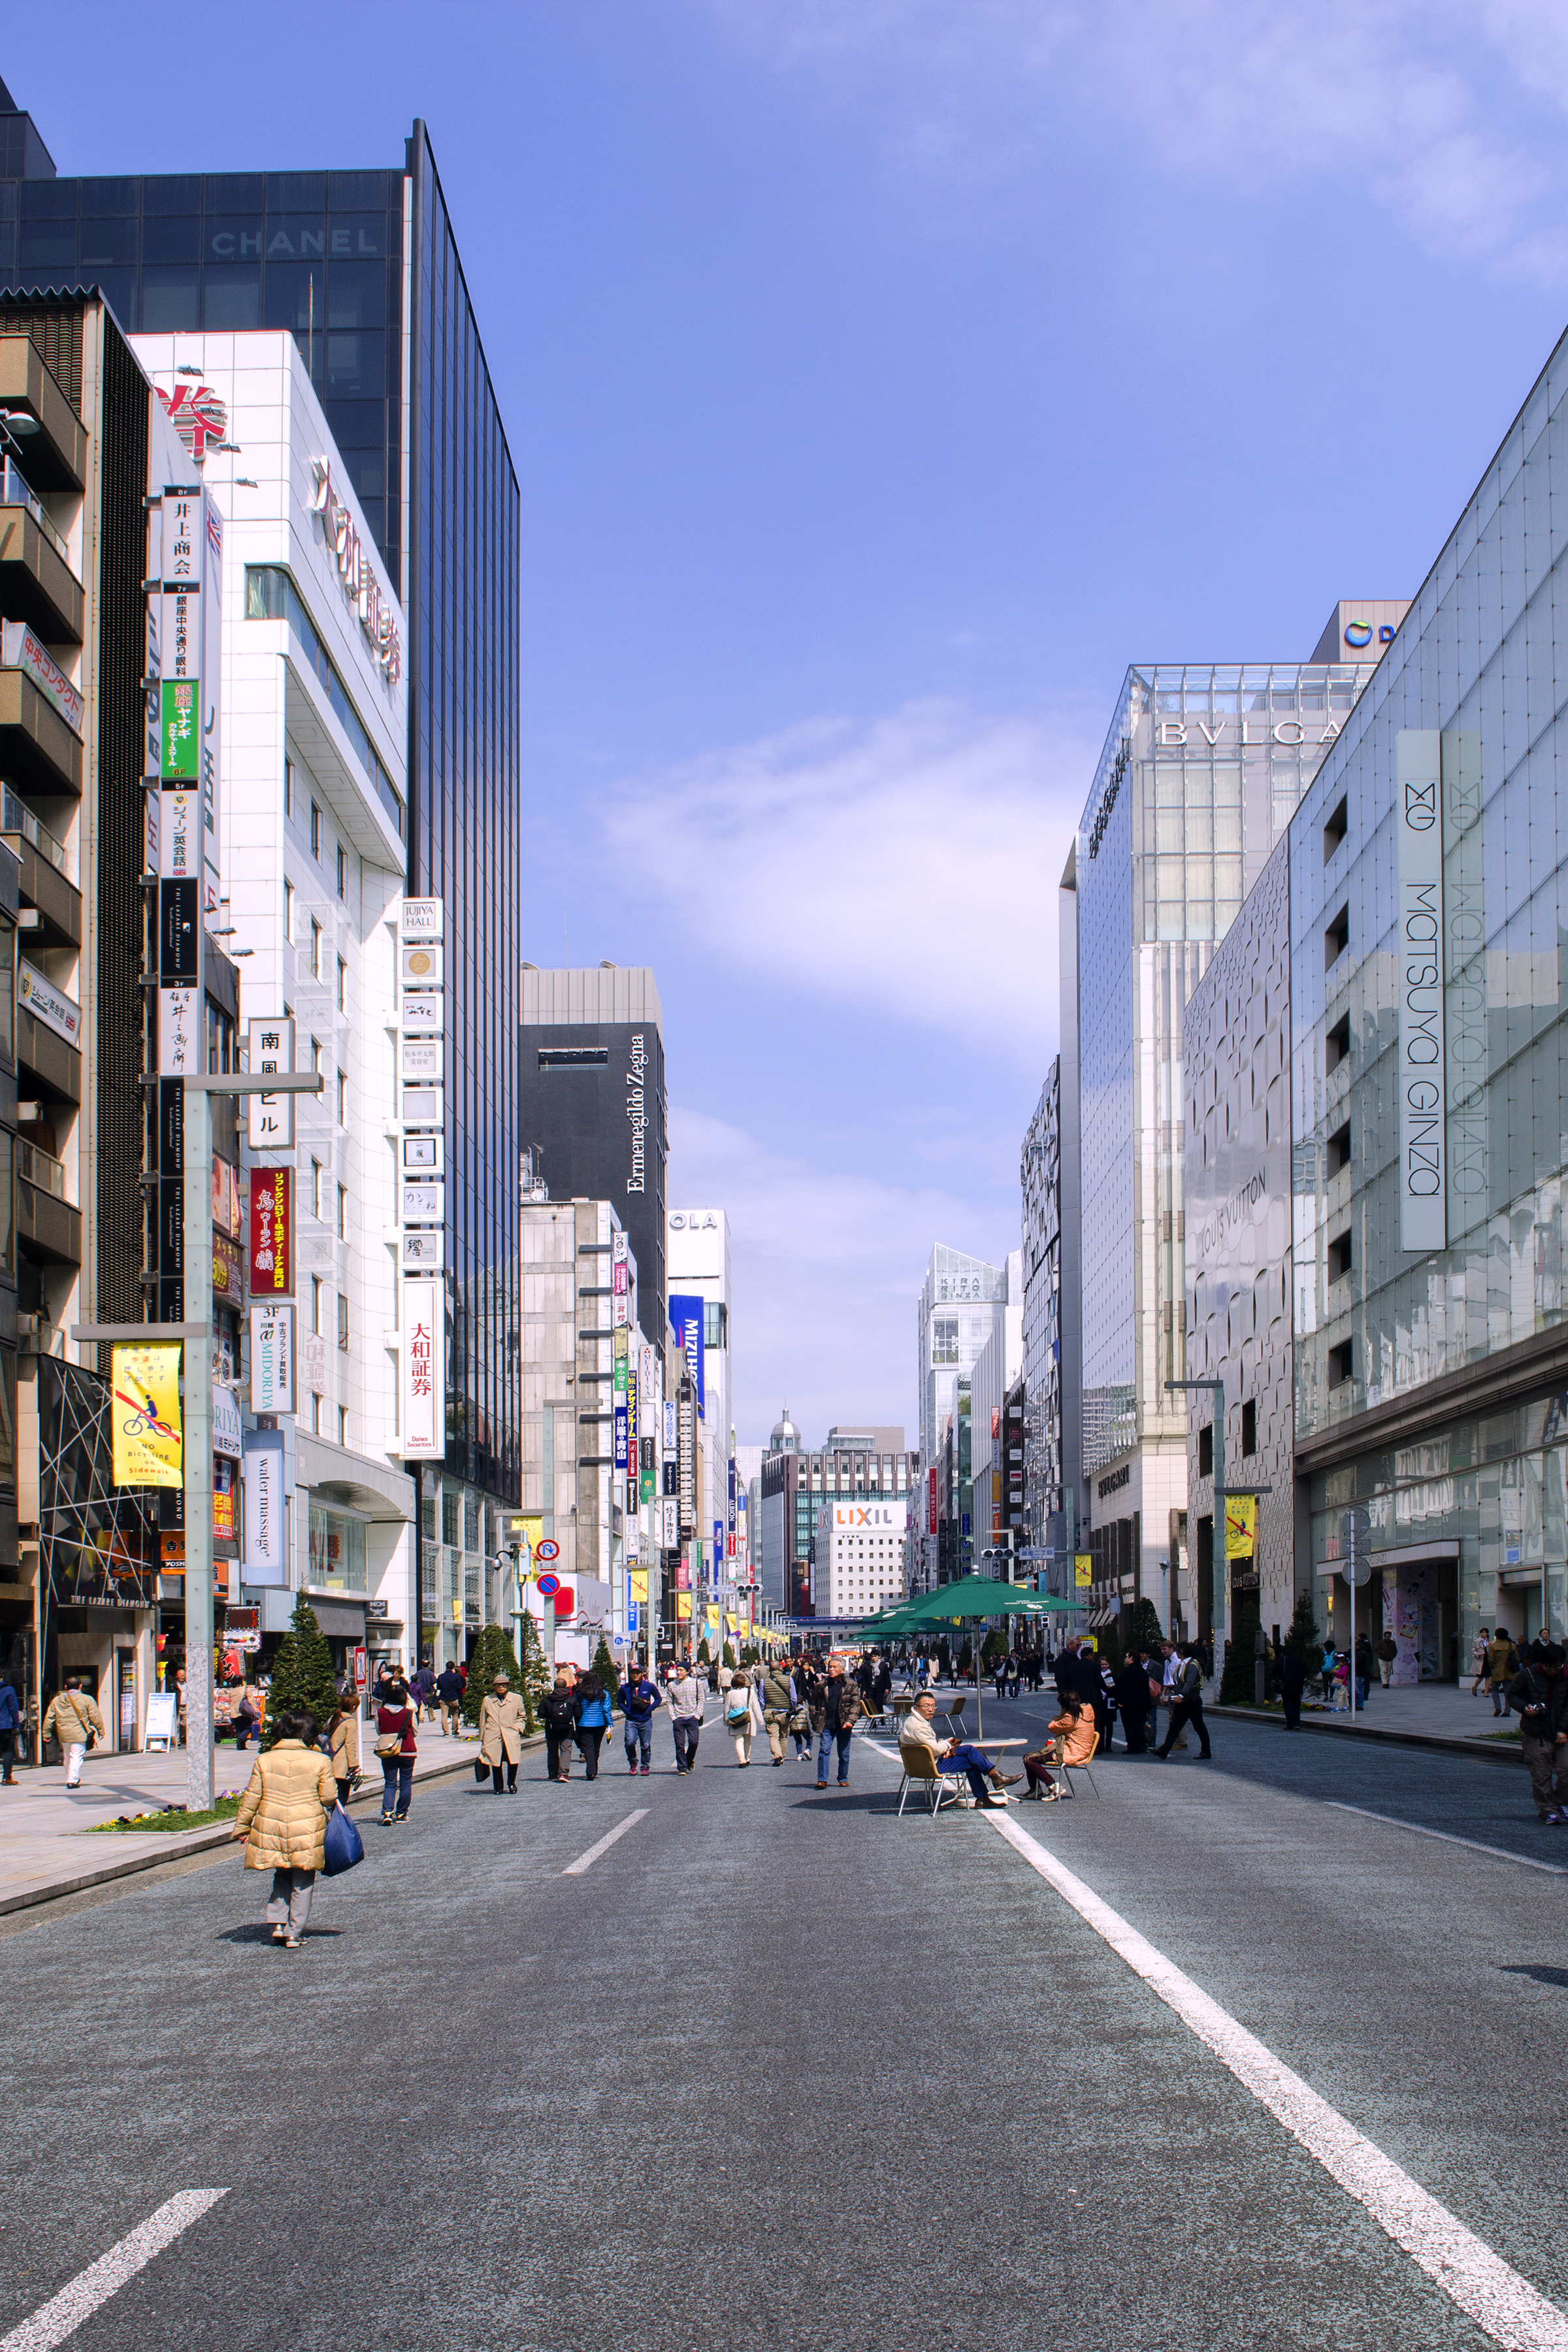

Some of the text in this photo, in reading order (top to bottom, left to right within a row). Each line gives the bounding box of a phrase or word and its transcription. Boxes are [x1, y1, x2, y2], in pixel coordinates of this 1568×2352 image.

[212, 229, 376, 256] CHANEL
[174, 503, 191, 575] 井上商会
[176, 596, 187, 677] 銀座中央通り眼科
[25, 636, 79, 712] 中央コンタクト
[174, 684, 193, 740] 銀座ヤナギ
[173, 806, 187, 867] シェーン英会話
[406, 906, 433, 916] JUJIYA
[407, 918, 432, 926] HALL
[32, 987, 65, 1020] シェーン英会話
[627, 1034, 649, 1194] Ermenegildo Zegna
[1407, 1080, 1440, 1197] GINZA
[670, 1213, 717, 1228] OLA
[1202, 1166, 1266, 1256] LOUIS VUITTON
[263, 1307, 280, 1318] 3F
[262, 1343, 273, 1409] MIDORIYA
[278, 1322, 287, 1389] 中古ブランド買取販売
[410, 1323, 431, 1396] 大和証券
[128, 1451, 169, 1460] Bicycling
[616, 1416, 627, 1460] 洋服の青山
[255, 1458, 270, 1555] water massage
[817, 1509, 832, 1528] LIXIL
[837, 1507, 892, 1527] LIXIL
[71, 1595, 150, 1608] THE LAZARE DIAMOND
